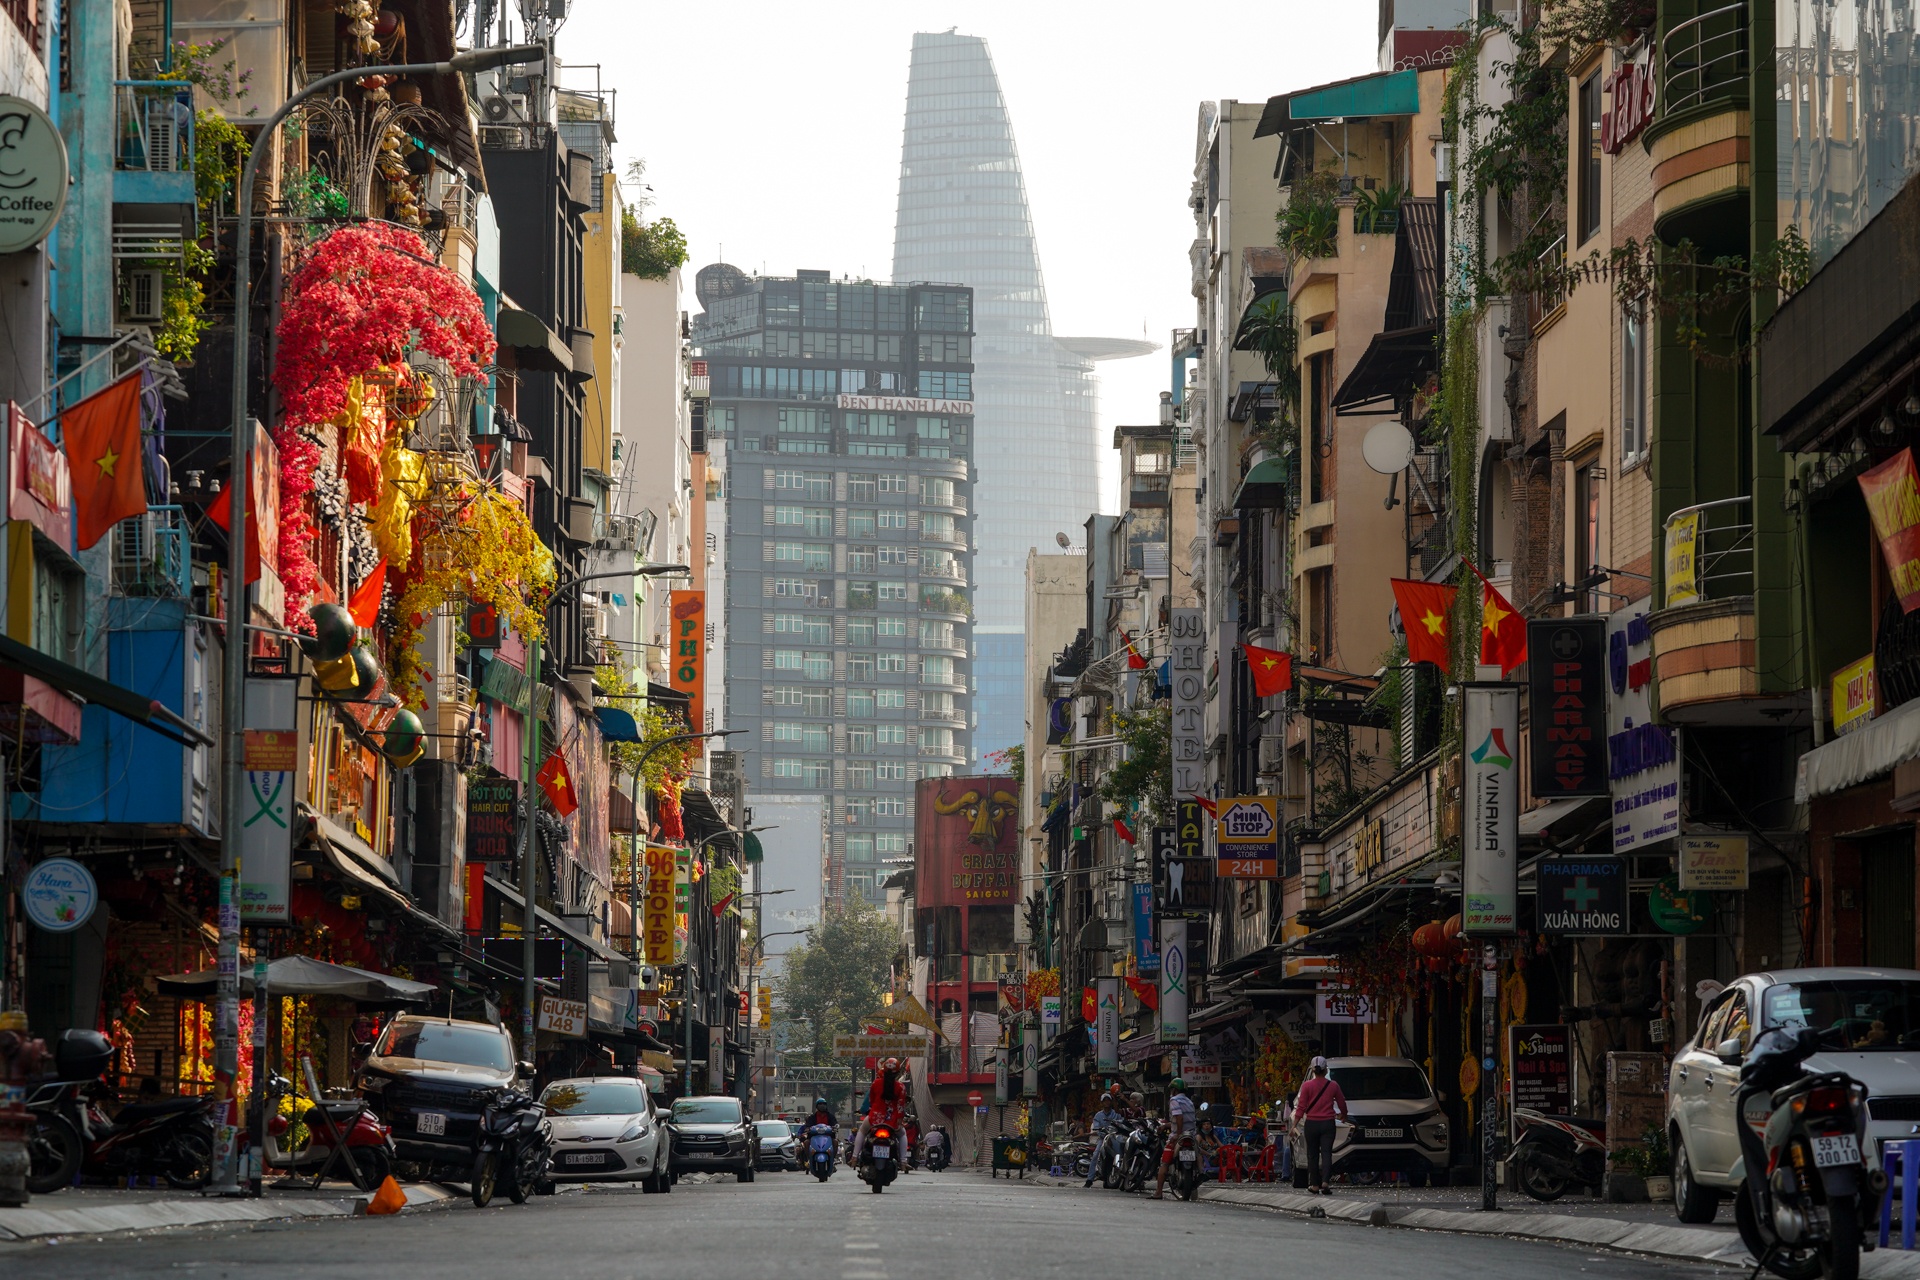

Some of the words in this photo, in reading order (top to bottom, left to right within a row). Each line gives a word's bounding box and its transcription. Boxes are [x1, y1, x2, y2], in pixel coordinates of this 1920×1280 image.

[18, 217, 35, 225] egg
[840, 395, 869, 409] BEN
[871, 397, 928, 412] THANH
[932, 399, 973, 414] LAND
[1173, 615, 1201, 638] 99
[1174, 644, 1202, 793] HOTEL
[1547, 662, 1592, 791] PHARMACY
[262, 771, 270, 796] ROUP
[472, 803, 491, 812] HAIR
[494, 803, 509, 812] CUT
[1485, 772, 1499, 851] VINAMA
[1233, 812, 1262, 822] MINI
[1232, 822, 1264, 832] STOP
[646, 851, 674, 876] 96
[962, 854, 1019, 869] CRAZY
[1231, 860, 1263, 875] 24H
[1543, 864, 1620, 875] PHARMACY
[966, 890, 1009, 899] SAIGON
[648, 879, 671, 961] HOTEL
[1544, 909, 1579, 929] XUÂN
[1582, 909, 1620, 929] HỒNG
[548, 1015, 573, 1032] 148
[1288, 1022, 1316, 1034] Tiger
[1517, 1060, 1536, 1073] Nail
[1539, 1060, 1546, 1073] &
[1549, 1060, 1567, 1075] Spa
[424, 1114, 440, 1124] 51D
